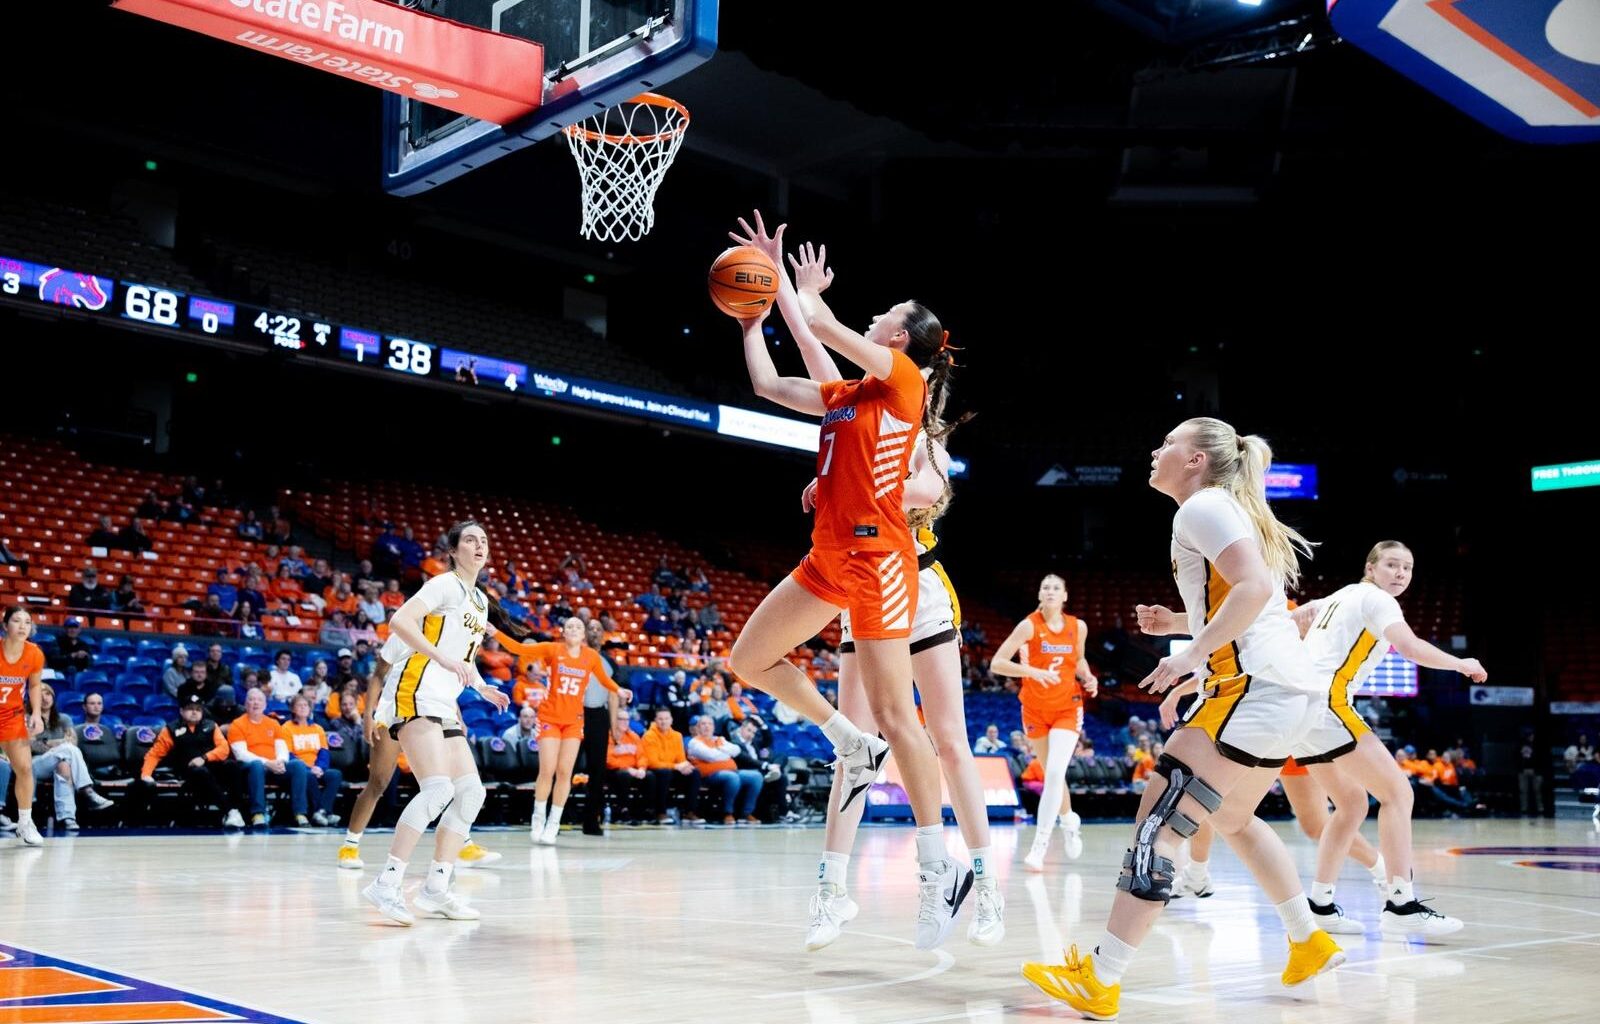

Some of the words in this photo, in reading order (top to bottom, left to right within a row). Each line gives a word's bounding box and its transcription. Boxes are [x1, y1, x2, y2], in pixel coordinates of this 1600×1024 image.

[228, 0, 405, 54] tateFarm
[3, 272, 20, 294] 3
[735, 271, 773, 287] ELITE
[125, 285, 178, 325] 68
[202, 312, 218, 333] 0
[254, 312, 301, 340] 4:22
[315, 332, 327, 345] 4
[355, 343, 364, 362] 1
[388, 339, 432, 375] 38
[505, 373, 517, 391] 4
[820, 431, 836, 476] 7
[1533, 467, 1560, 480] FREE
[557, 675, 582, 696] 35
